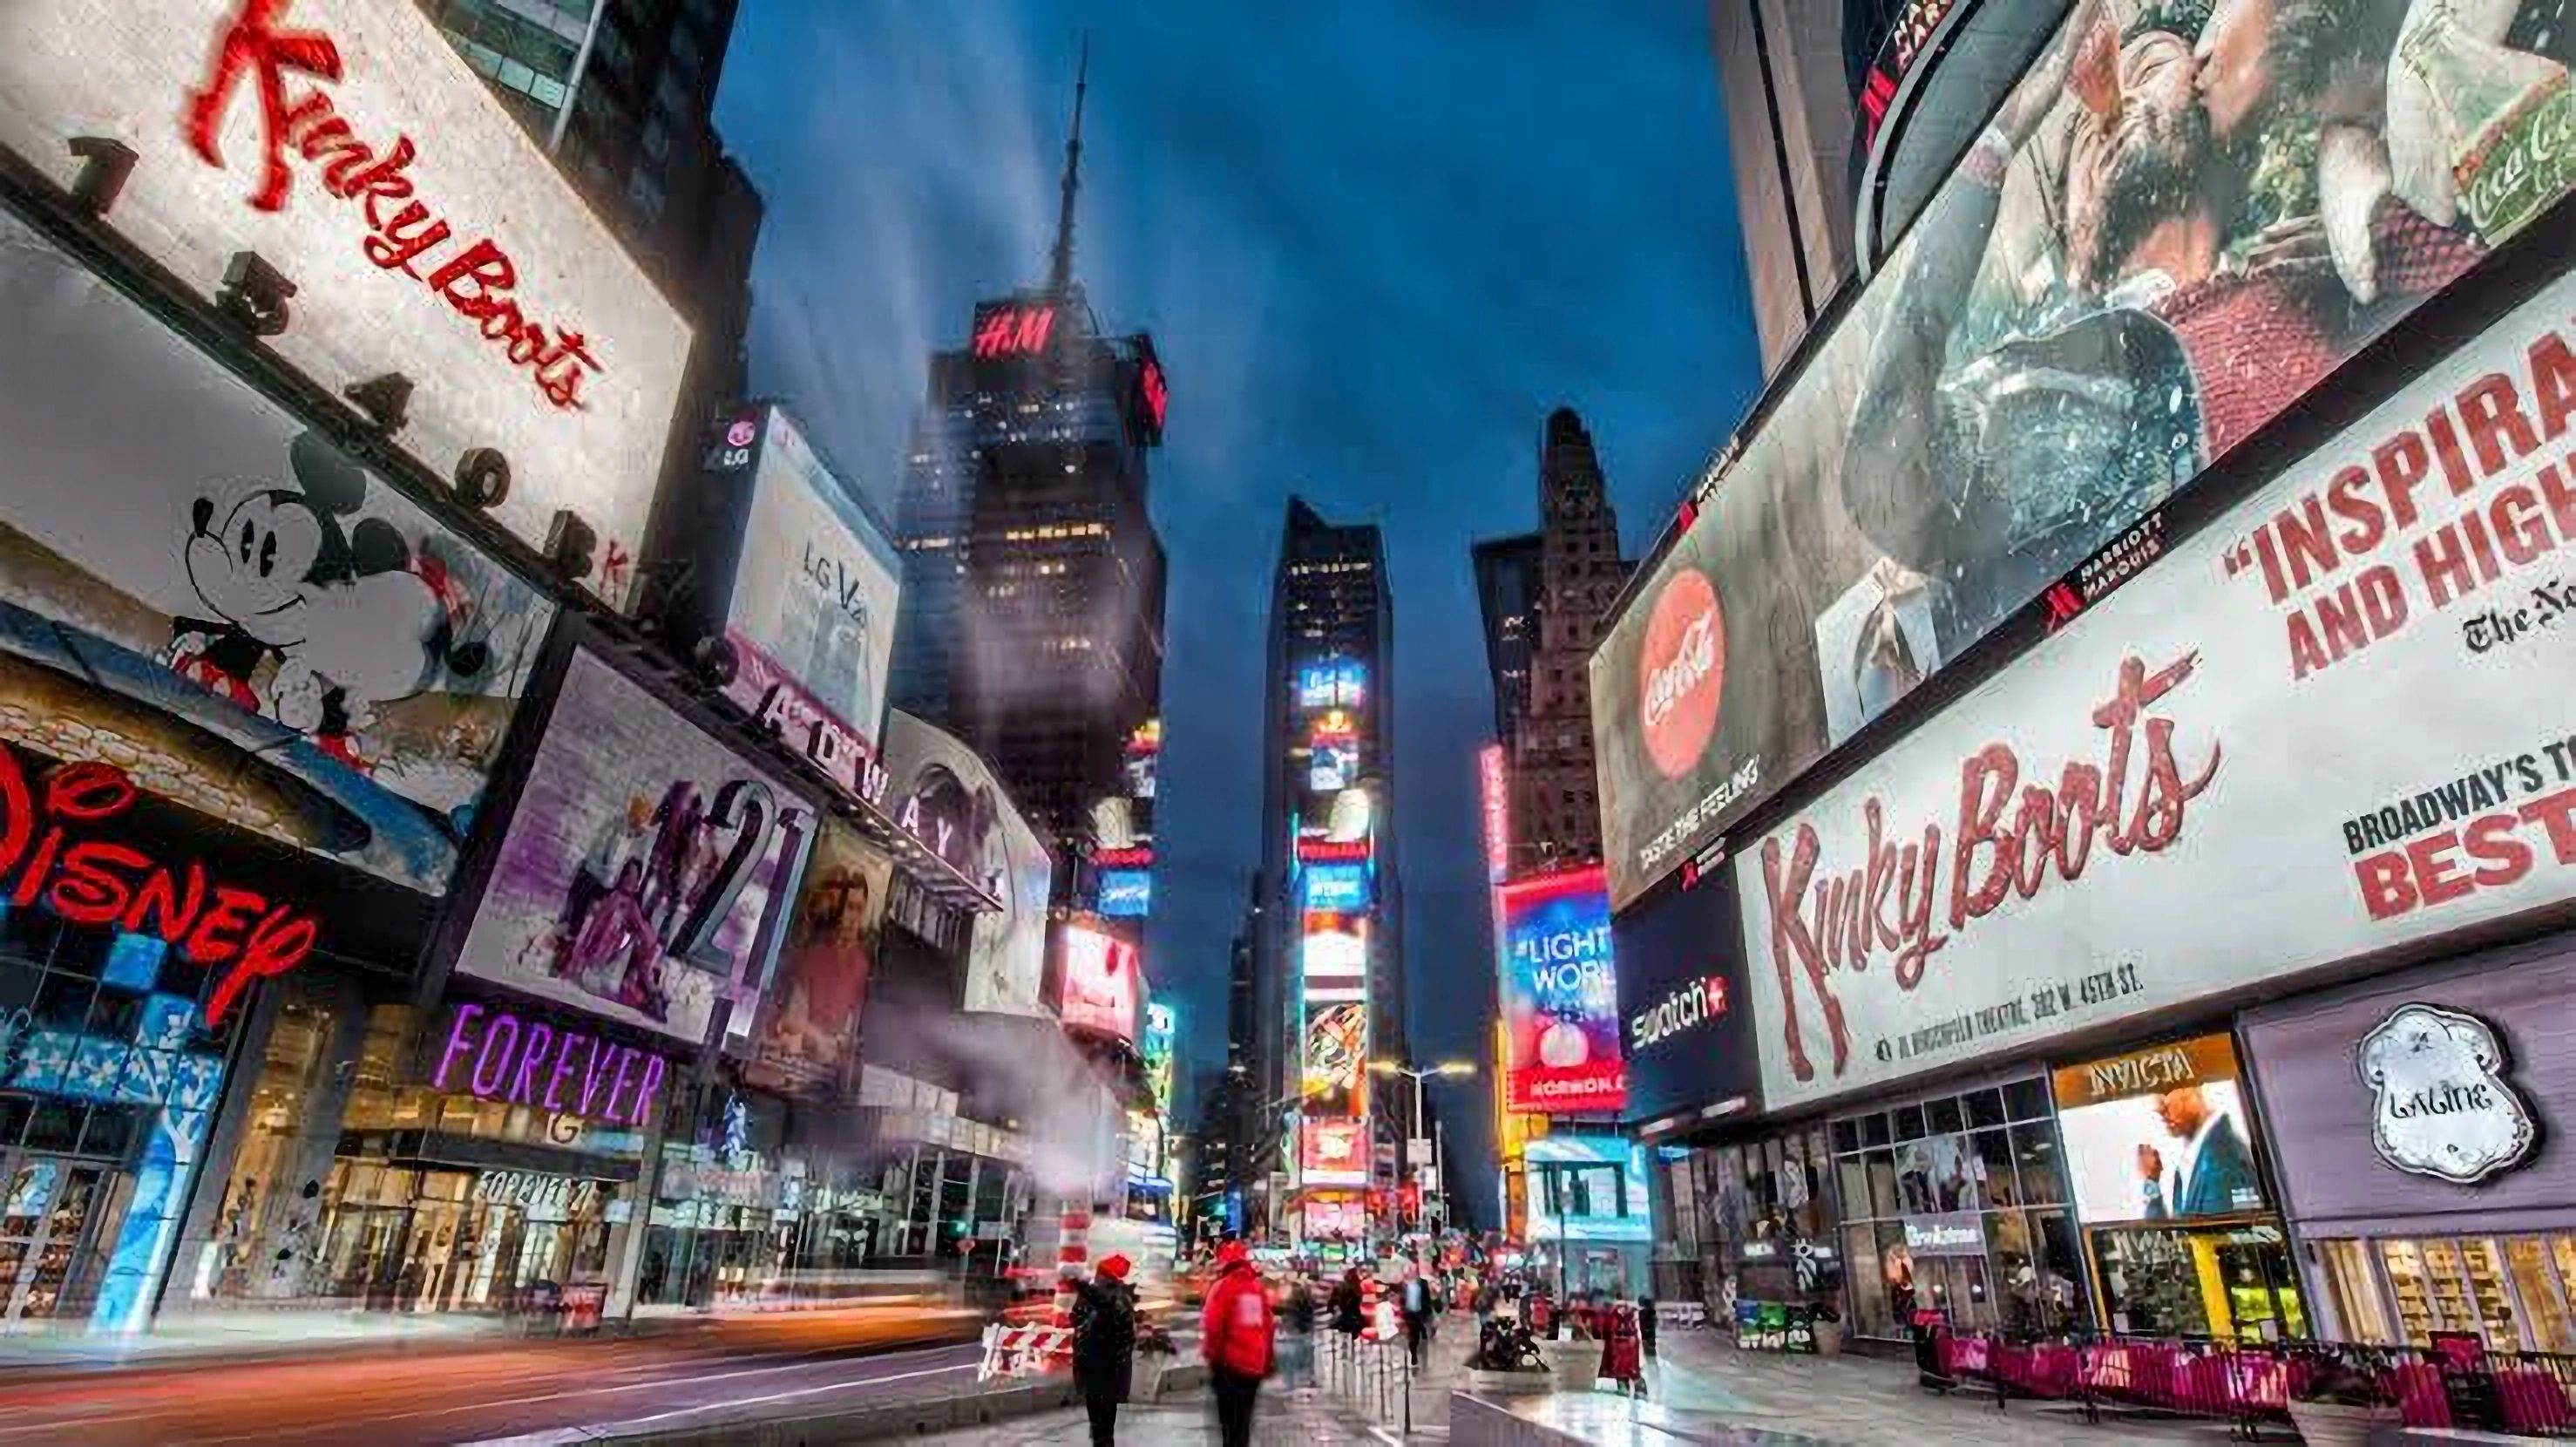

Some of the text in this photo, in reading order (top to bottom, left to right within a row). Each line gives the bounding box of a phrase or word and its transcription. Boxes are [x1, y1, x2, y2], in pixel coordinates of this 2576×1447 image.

[185, 0, 605, 411] Kinky Boots
[2286, 565, 2409, 681] AND
[2463, 608, 2529, 653] The
[1761, 796, 1949, 1082] Kinky
[1949, 649, 2222, 929] Boots
[2342, 754, 2544, 855] BROADWAY'S
[2354, 787, 2576, 921] BEST
[434, 1004, 665, 1127] FOREVER
